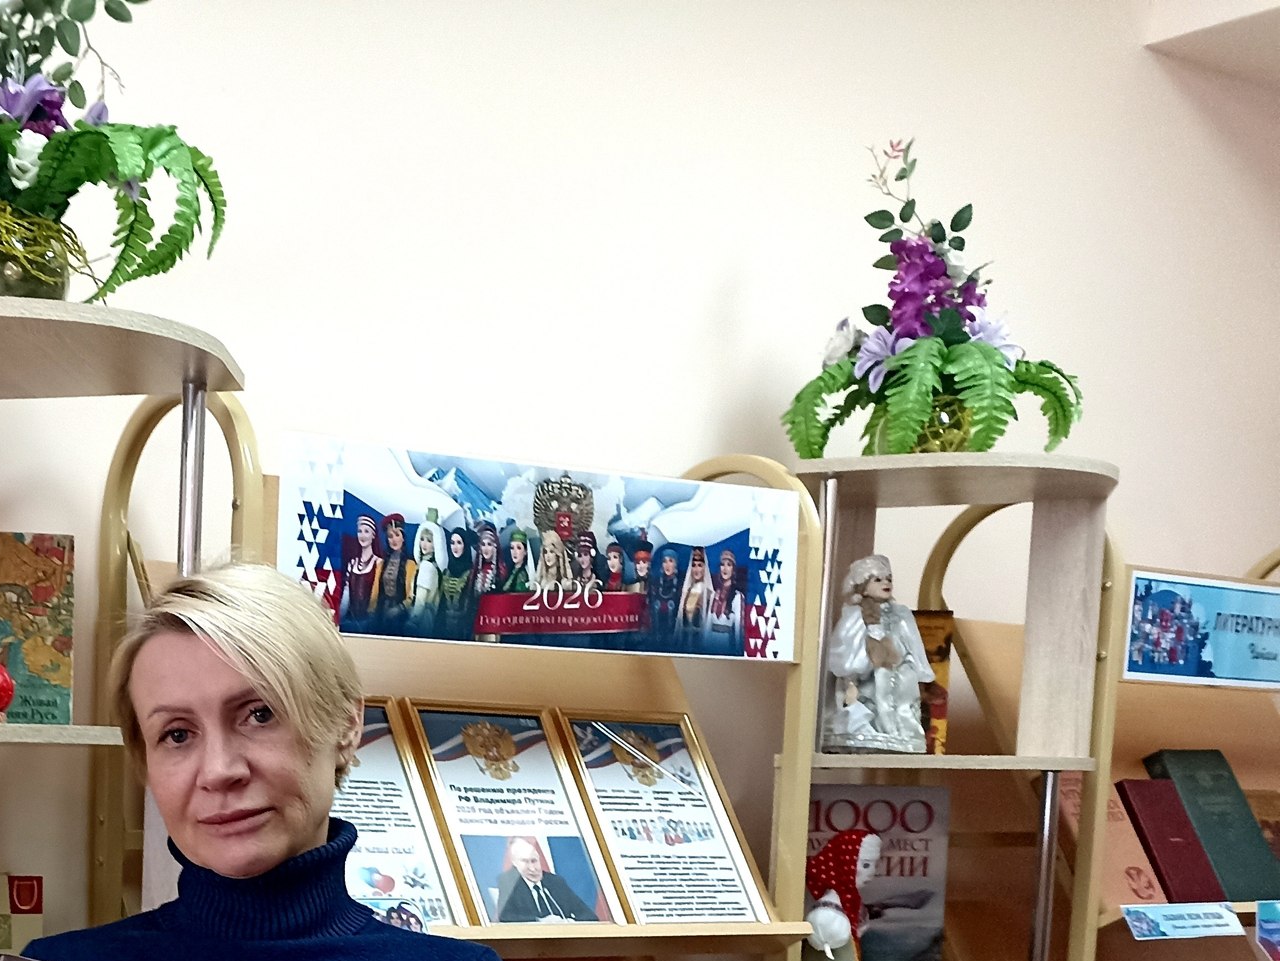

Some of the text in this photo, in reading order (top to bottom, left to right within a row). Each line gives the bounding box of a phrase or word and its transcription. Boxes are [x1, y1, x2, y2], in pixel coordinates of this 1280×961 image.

[523, 579, 603, 611] 2026
[809, 799, 935, 833] 1000
[888, 838, 933, 852] МЕСТ
